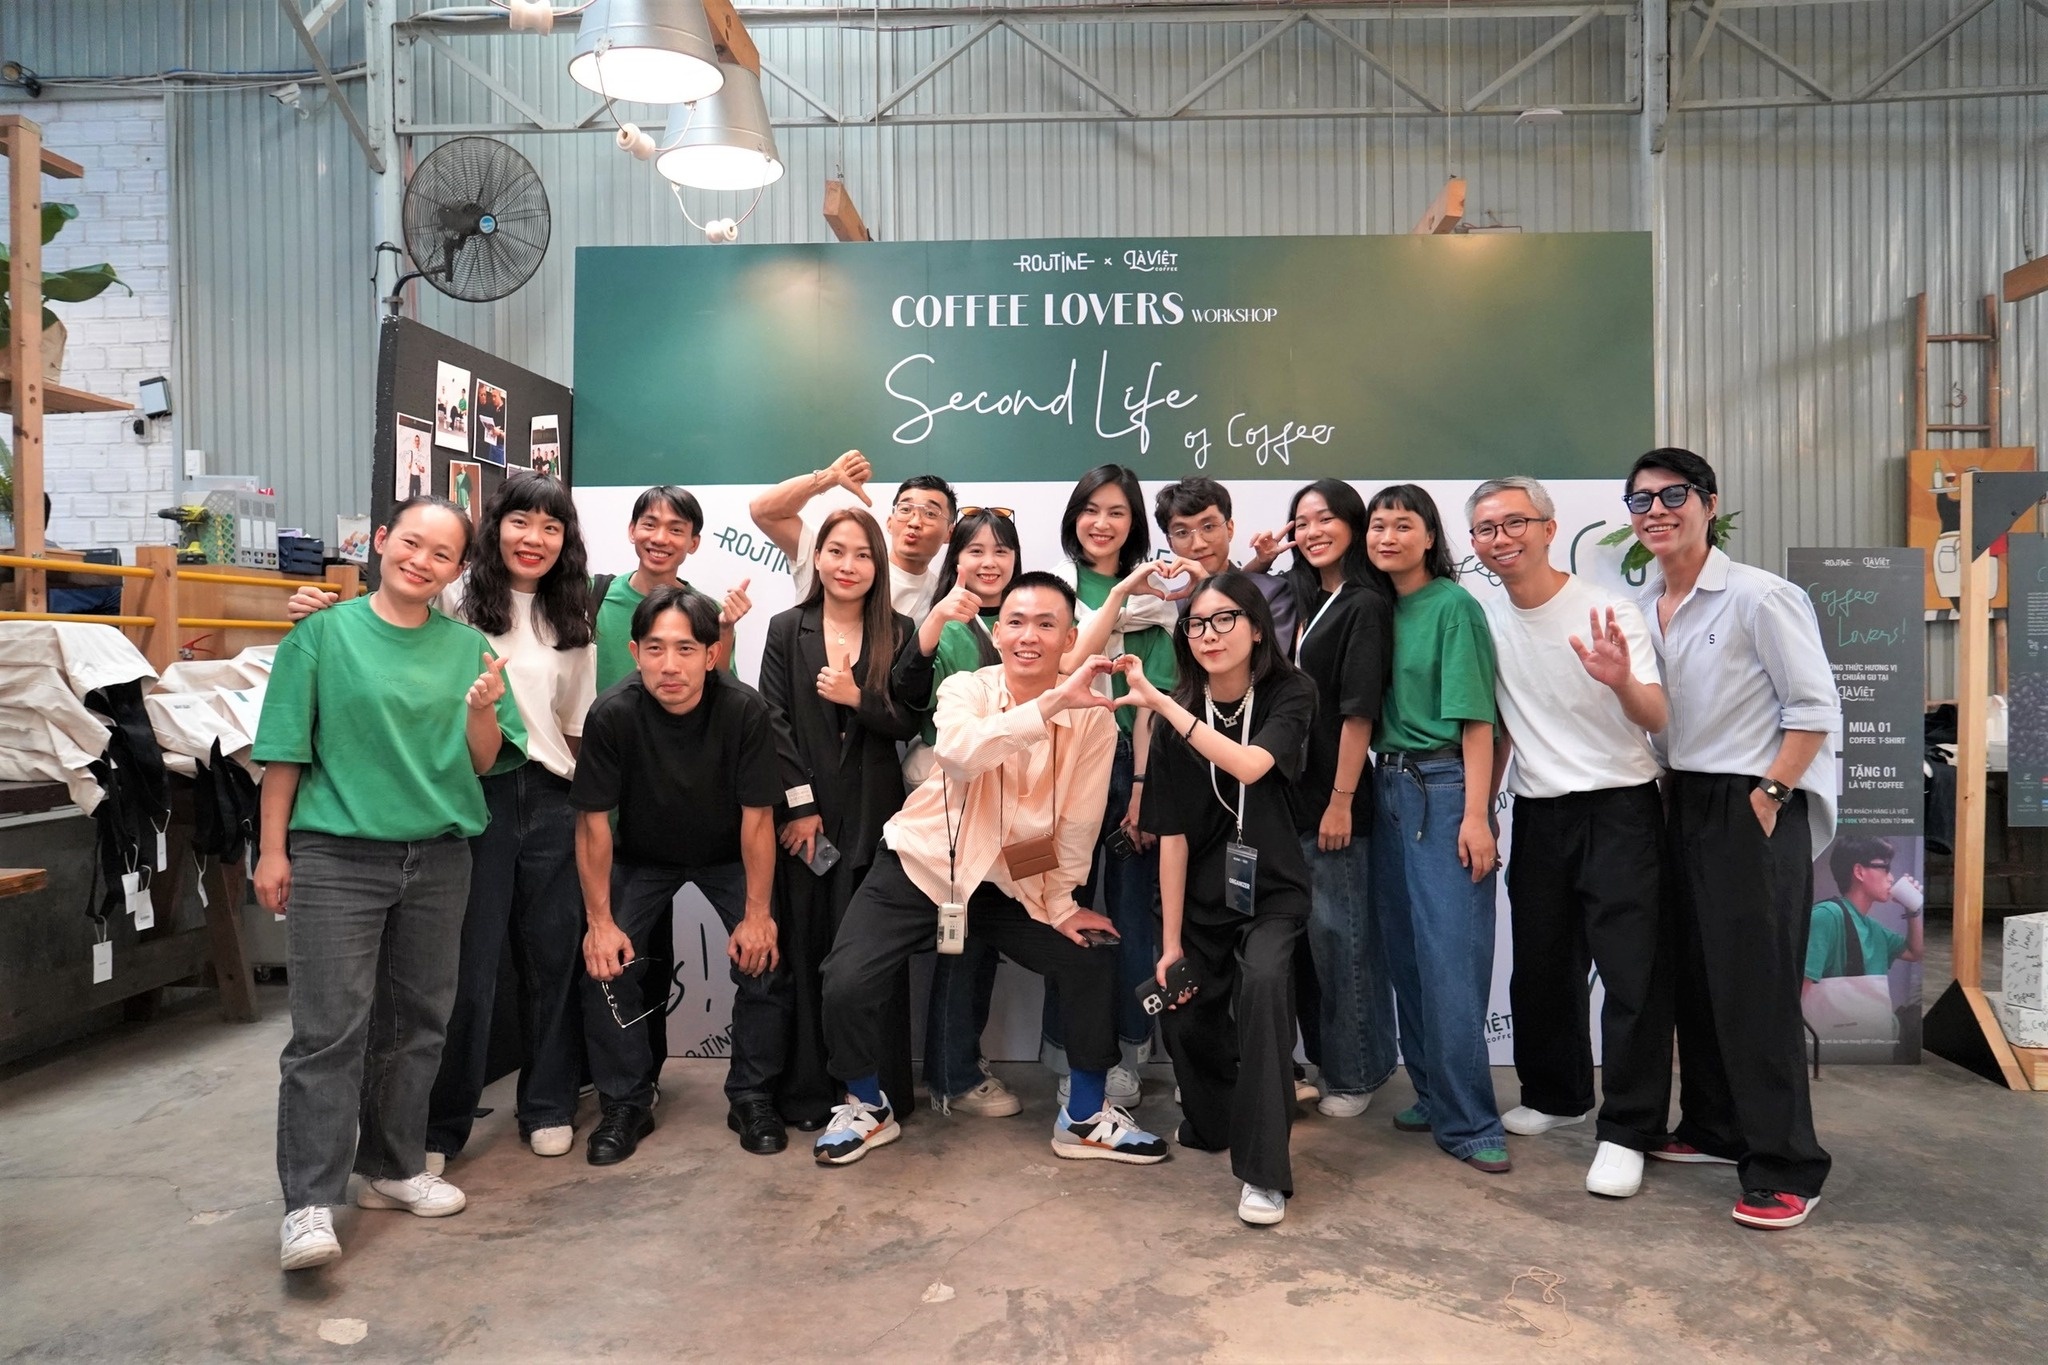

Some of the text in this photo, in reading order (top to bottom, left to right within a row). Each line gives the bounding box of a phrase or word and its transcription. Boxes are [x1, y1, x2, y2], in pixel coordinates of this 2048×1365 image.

[891, 292, 1278, 328] COFFEE LOVERS WORKSHOP
[885, 349, 1198, 455] Second Life
[713, 526, 791, 575] ROUTIN
[1709, 633, 1715, 644] S
[1849, 722, 1891, 733] MUA 01
[1849, 737, 1906, 745] COFFEE T-SHIRT
[1849, 764, 1896, 780] TẶNG 01
[1848, 780, 1904, 790] LÀ VIỆT COFFEE
[1486, 1033, 1512, 1043] COFFE
